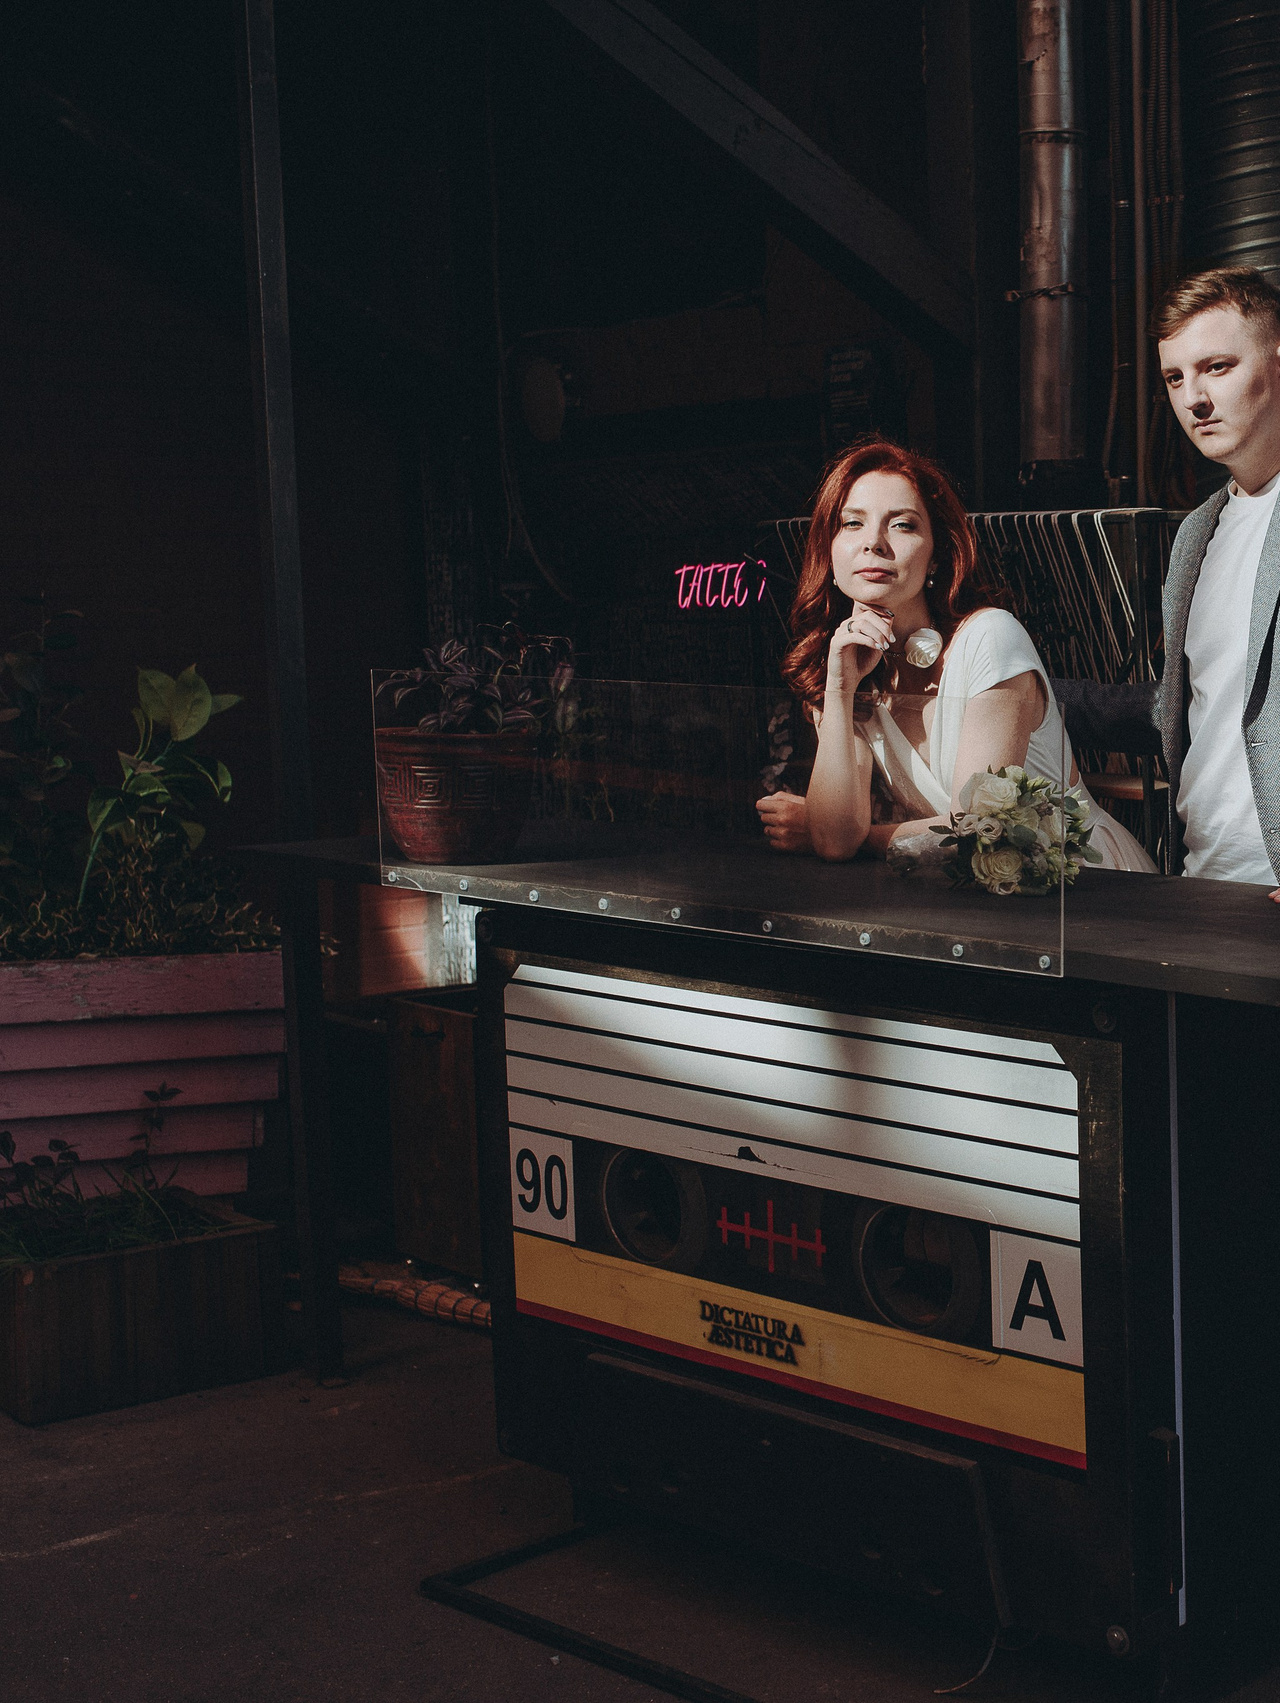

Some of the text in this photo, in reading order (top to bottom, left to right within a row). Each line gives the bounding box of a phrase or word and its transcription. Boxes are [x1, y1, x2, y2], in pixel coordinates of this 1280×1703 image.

[515, 1149, 568, 1221] 90
[700, 1301, 805, 1347] DICTATURA
[1009, 1259, 1067, 1341] A
